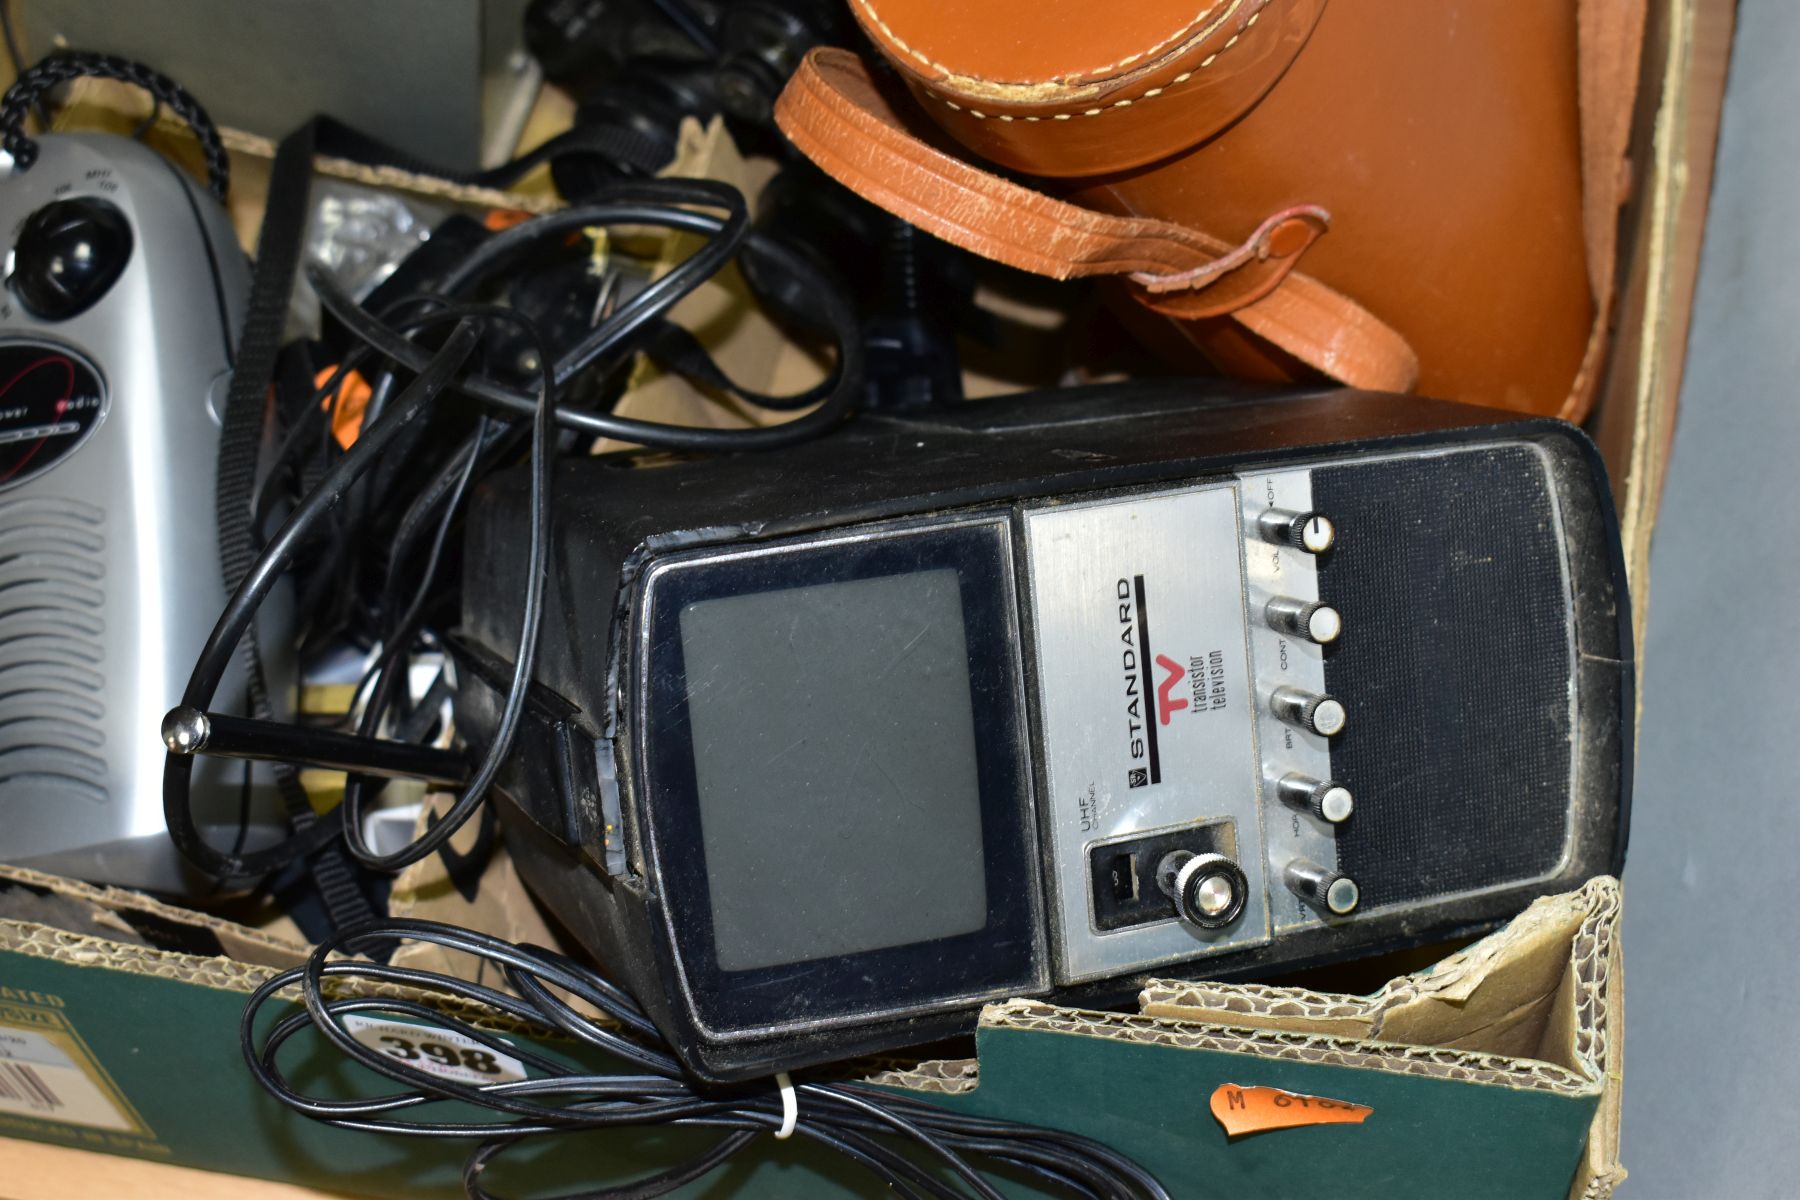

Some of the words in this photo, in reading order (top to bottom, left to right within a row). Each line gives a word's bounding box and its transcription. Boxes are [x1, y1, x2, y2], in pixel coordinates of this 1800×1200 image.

[1267, 477, 1275, 500] OFF
[1273, 549, 1281, 574] VOL
[1117, 577, 1145, 759] STANDARD
[1279, 639, 1289, 671] CONT
[1155, 653, 1189, 726] TV
[1188, 655, 1208, 713] transistor
[1207, 650, 1227, 711] television
[1285, 728, 1293, 750] BRT
[1079, 796, 1091, 833] UHF
[1089, 780, 1099, 831] CHANNEL
[379, 1035, 502, 1075] 398
[1226, 1090, 1246, 1110] M
